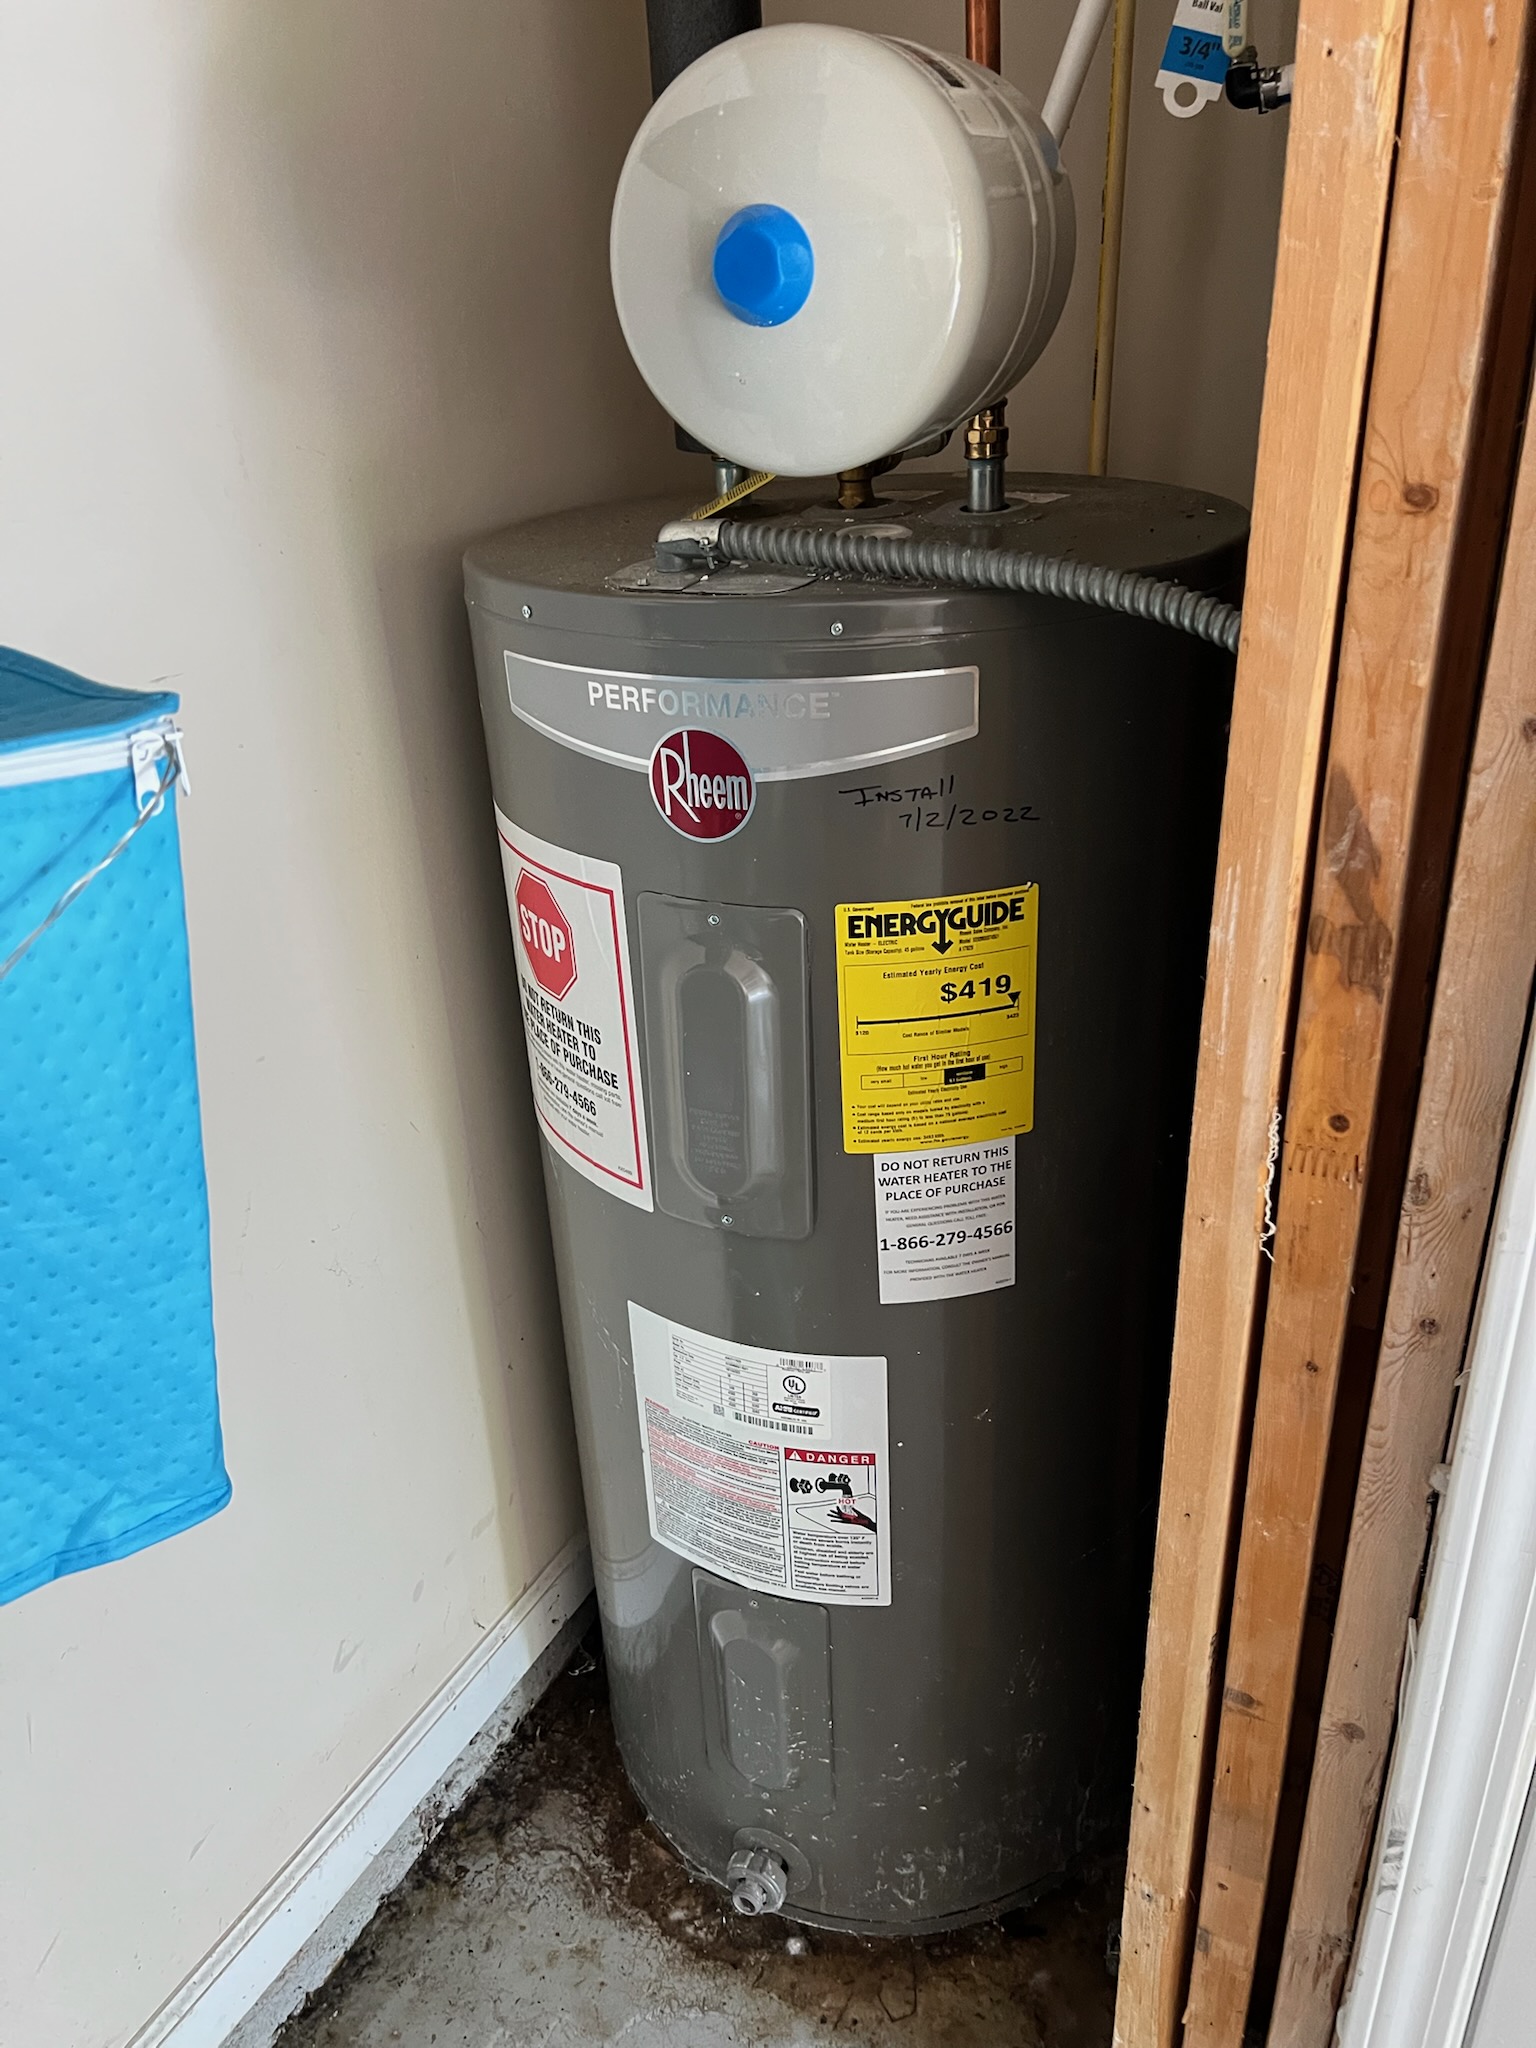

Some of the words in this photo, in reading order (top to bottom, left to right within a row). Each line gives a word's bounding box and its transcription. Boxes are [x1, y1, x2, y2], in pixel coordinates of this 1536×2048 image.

[1179, 36, 1221, 60] 3/4"
[660, 729, 749, 823] Rheem
[899, 804, 1040, 832] 7/2/2022
[847, 896, 1025, 939] ENERGYGUIDE
[520, 903, 566, 963] STOP
[883, 970, 917, 979] Estimated
[920, 967, 942, 976] Yearly
[944, 965, 968, 974] Energy
[970, 962, 984, 971] Cost
[940, 974, 1011, 1004] $419
[540, 995, 574, 1032] RETURN
[576, 1020, 601, 1045] THIS
[546, 1016, 579, 1051] HEATER
[582, 1041, 596, 1061] TO
[550, 1039, 561, 1058] OF
[563, 1050, 619, 1090] PURCHASE
[949, 1050, 971, 1059] Rating
[881, 1162, 900, 1172] DO
[903, 1159, 929, 1170] NOT
[933, 1151, 980, 1167] RETURN
[983, 1146, 1009, 1159] THIS
[878, 1175, 920, 1187] WATER
[924, 1168, 968, 1183] HEATER
[971, 1165, 987, 1176] TO
[990, 1160, 1012, 1172] THE
[886, 1190, 922, 1201] PLACE
[925, 1187, 941, 1197] OF
[945, 1176, 1006, 1195] PURCHASE
[880, 1220, 1013, 1251] 1-866-279-4566
[748, 1440, 779, 1449] CAUTION
[806, 1453, 870, 1464] DANGER
